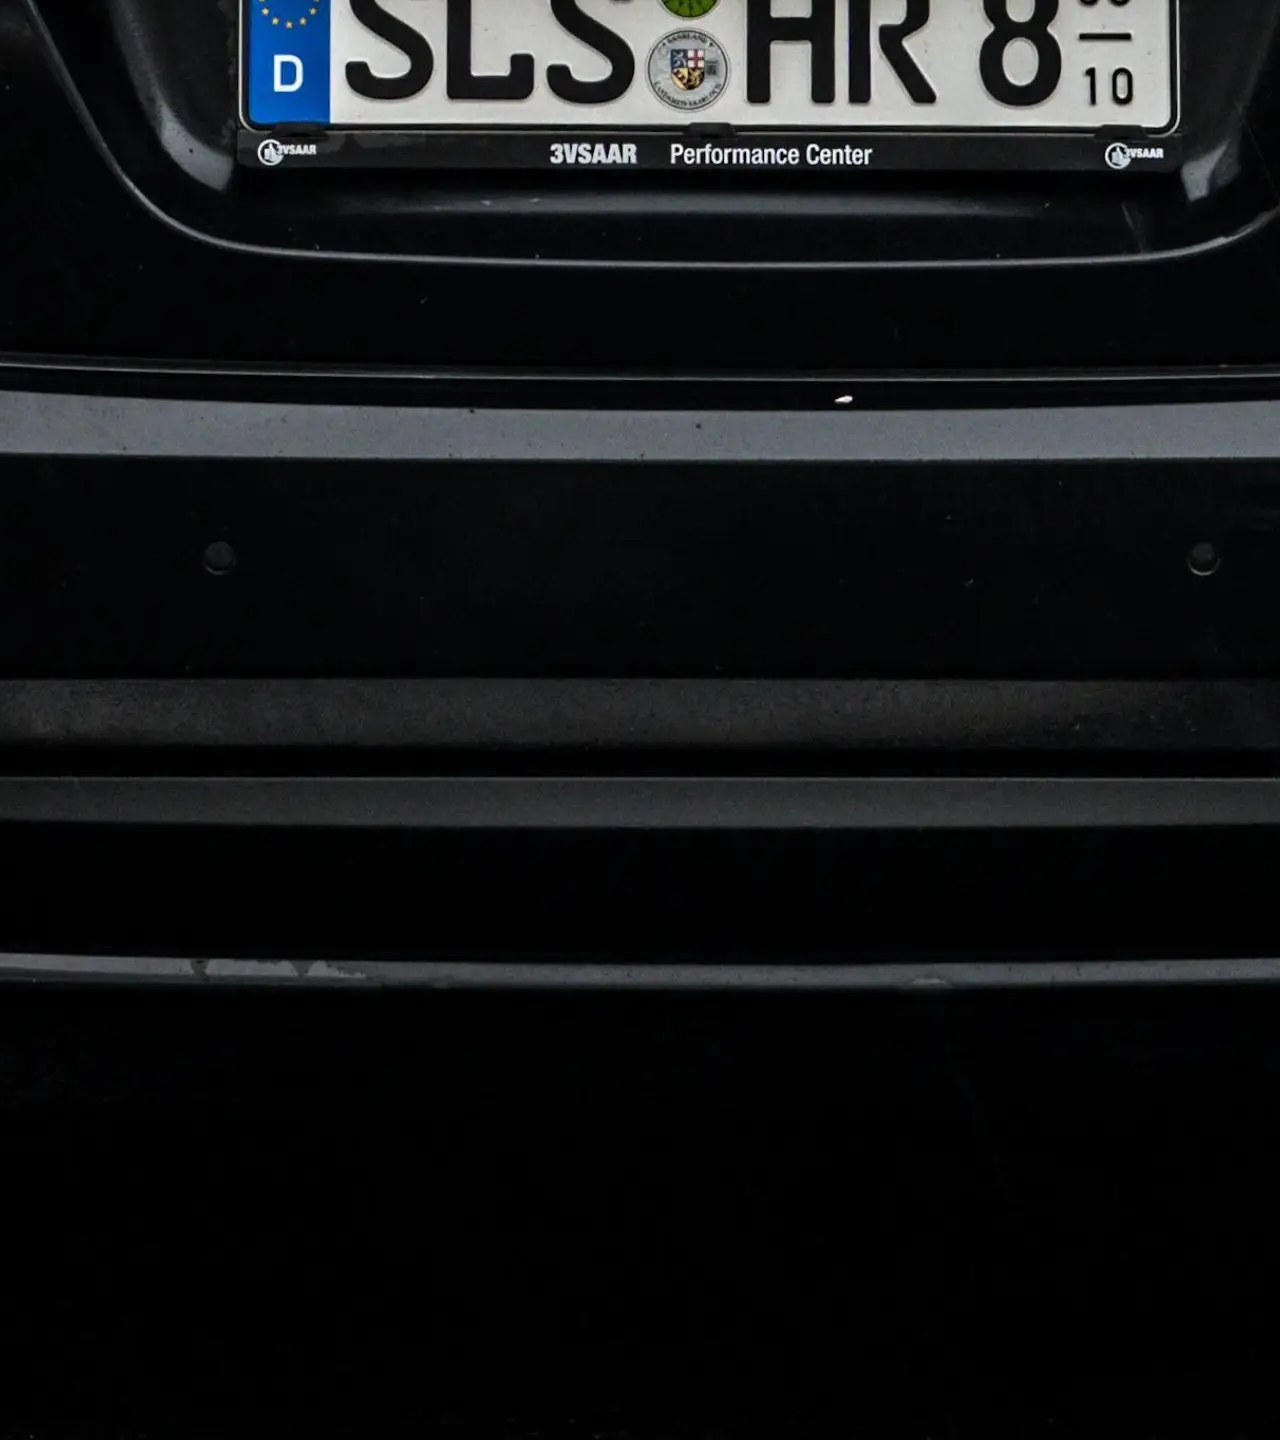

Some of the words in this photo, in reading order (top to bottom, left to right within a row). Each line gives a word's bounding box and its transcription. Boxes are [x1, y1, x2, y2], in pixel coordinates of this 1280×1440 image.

[273, 54, 303, 93] D
[1083, 67, 1134, 106] 10
[549, 143, 637, 164] 3VSAAR
[670, 143, 800, 165] Performance
[806, 143, 873, 165] Center
